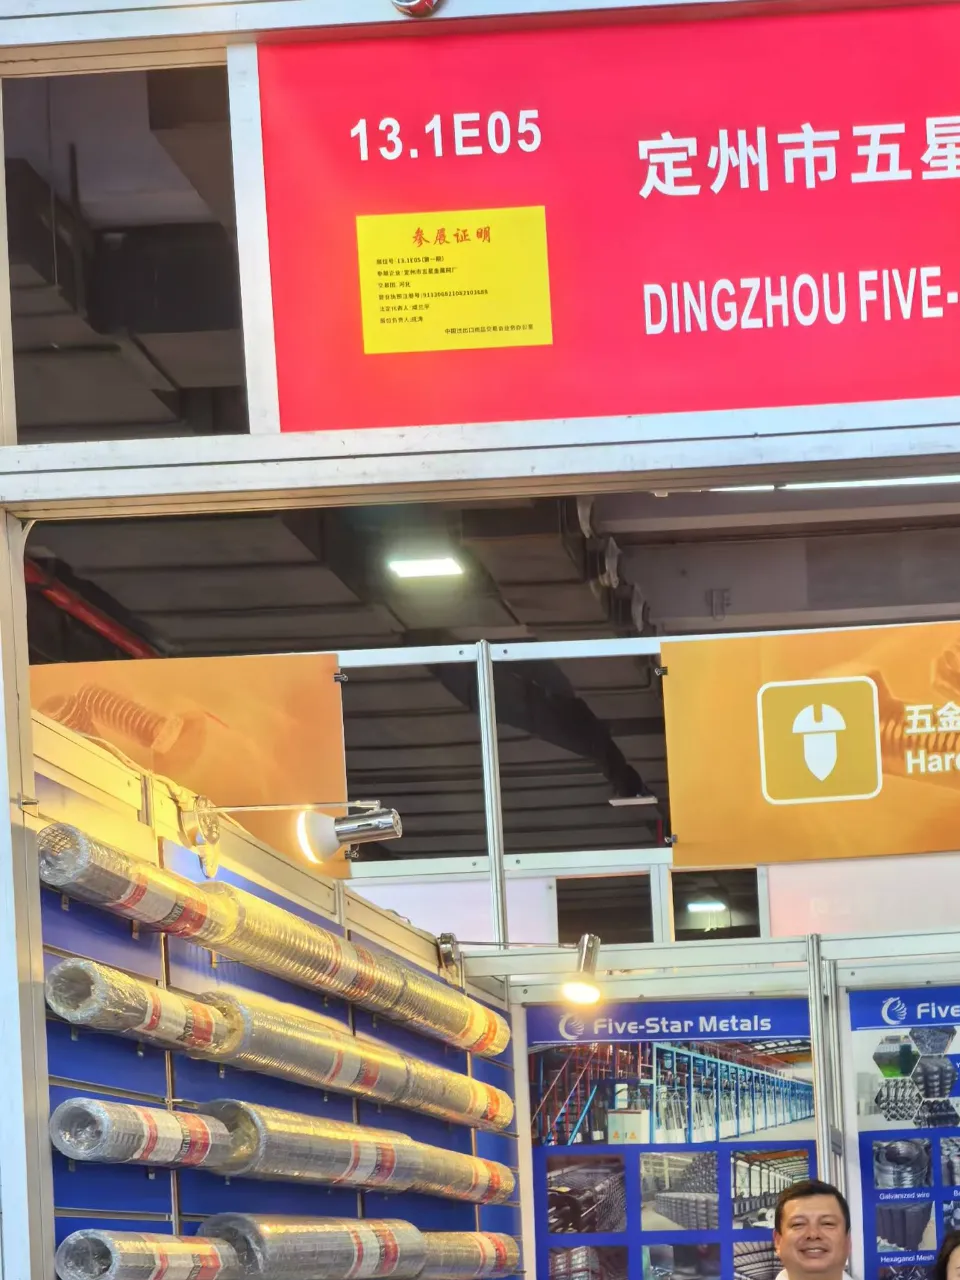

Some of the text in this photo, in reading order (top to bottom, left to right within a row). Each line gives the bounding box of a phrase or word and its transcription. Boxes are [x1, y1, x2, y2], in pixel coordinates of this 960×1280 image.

[349, 109, 542, 161] 13.1E05
[412, 226, 491, 248] 参展证明
[643, 271, 847, 335] DINGZHOU
[593, 1014, 772, 1034] Five-Star Metals
